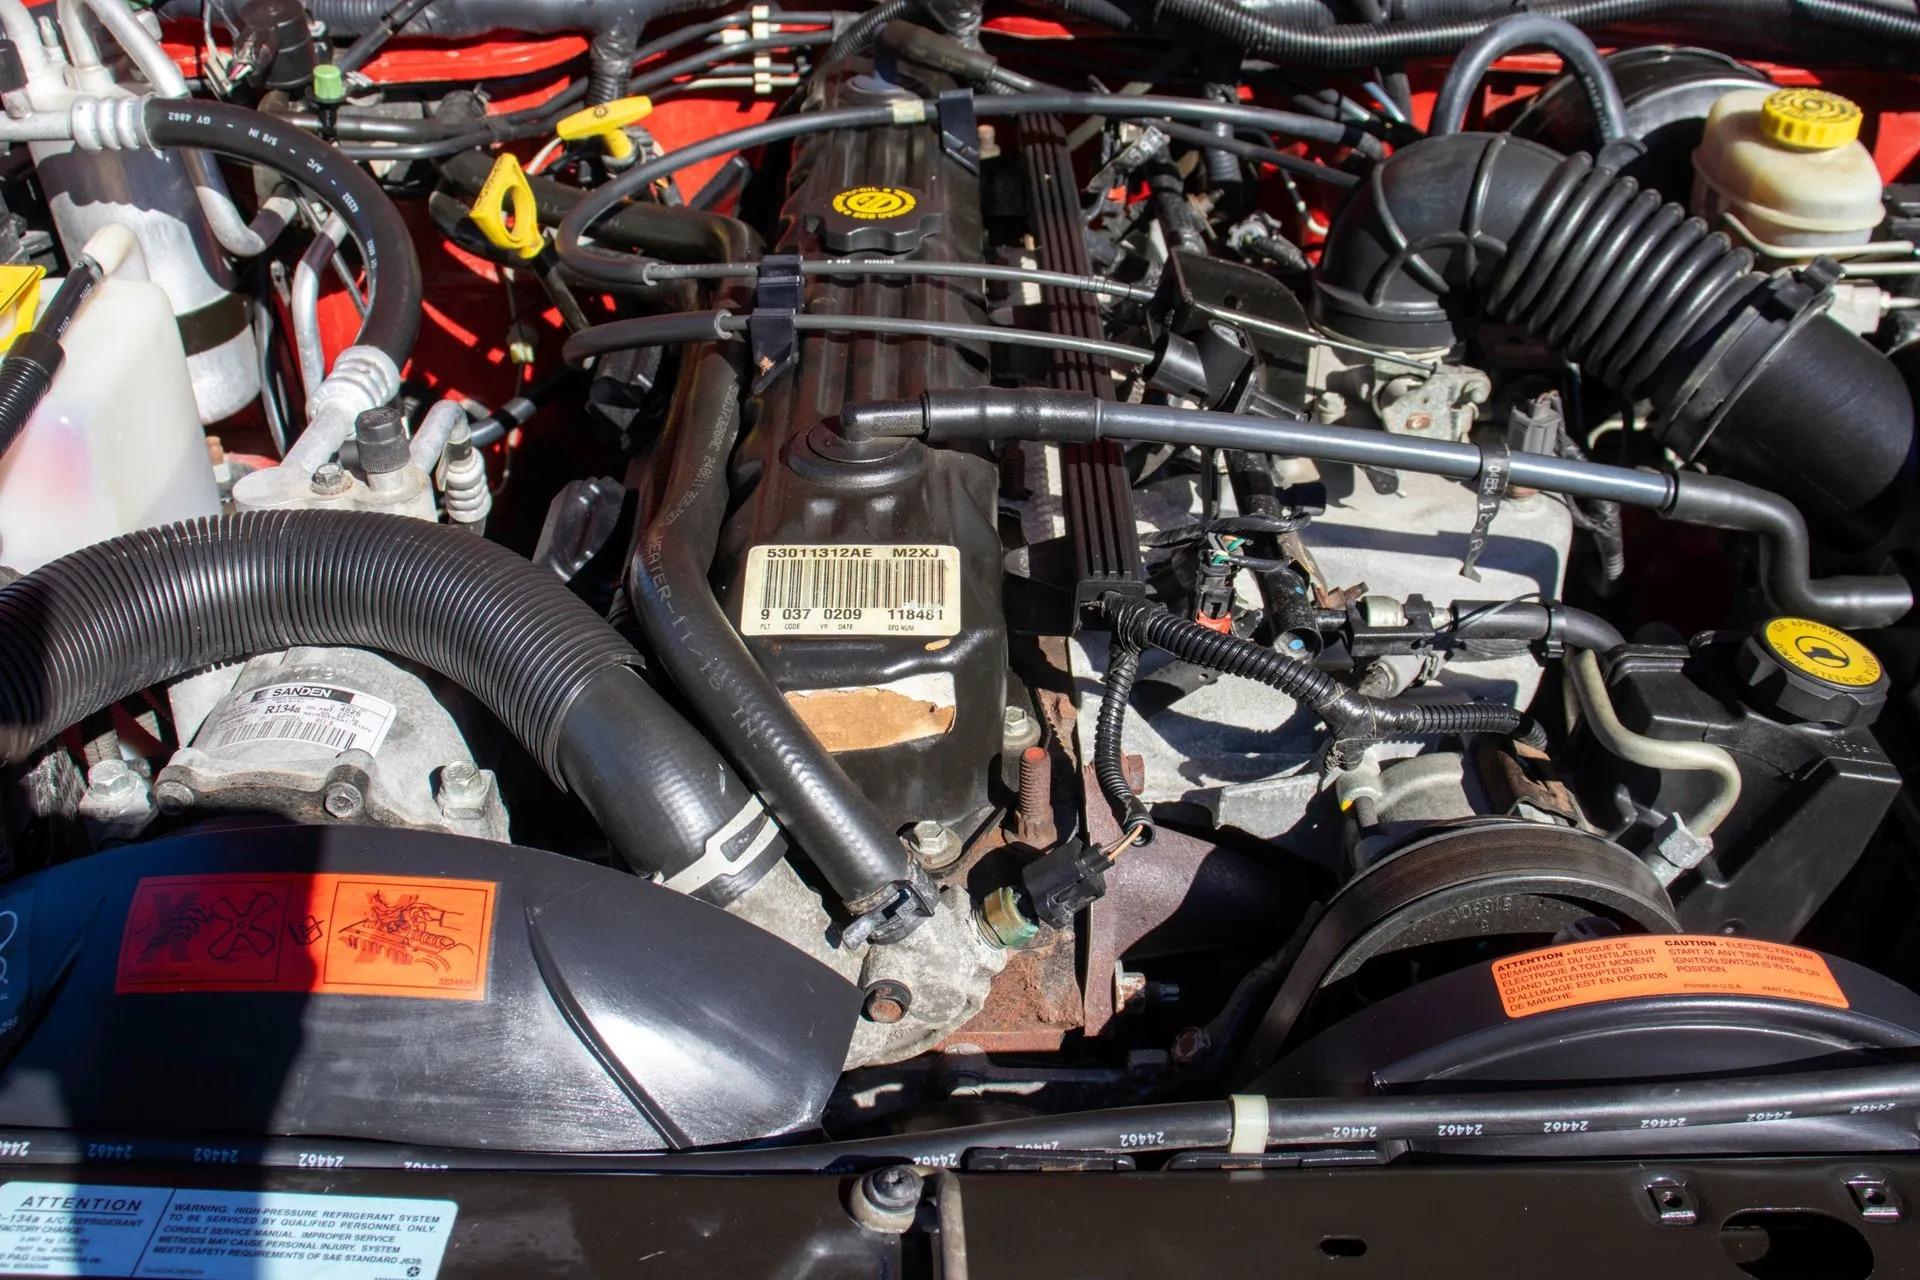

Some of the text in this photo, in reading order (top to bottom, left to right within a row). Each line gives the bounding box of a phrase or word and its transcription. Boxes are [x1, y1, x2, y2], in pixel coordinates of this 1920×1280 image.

[248, 128, 259, 138] IN
[306, 158, 324, 174] A/C
[767, 548, 940, 558] 53011312AE M2XJ
[760, 609, 770, 620] 9
[782, 609, 810, 620] 037
[824, 609, 862, 620] 0209
[1792, 620, 1848, 642] APPROVED
[272, 688, 332, 698] SANDEN
[264, 704, 301, 715] R134a
[1726, 942, 1775, 952] ELECTRIC
[1776, 948, 1794, 956] FAN
[1497, 952, 1563, 972] ATTENTION
[1573, 944, 1612, 956] RISQUE
[1615, 942, 1630, 950] DE
[1500, 948, 1656, 980] DEMARRAGE DU VENTILATEUR
[1578, 961, 1608, 970] TOUT
[1610, 956, 1656, 966] MOMENT
[1766, 954, 1794, 964] WHEN
[1720, 958, 1760, 968] SWITCH
[1784, 964, 1803, 974] THE
[1804, 968, 1820, 976] ON
[1504, 982, 1542, 996] QUAND
[1507, 972, 1668, 1004] D'ALLUMAGE EST EN POSITION
[1510, 1004, 1525, 1012] DE
[1850, 1102, 1896, 1114] 24462
[1640, 1117, 1686, 1129] 24462
[1747, 1110, 1792, 1122] 24462
[1332, 1126, 1377, 1138] 24462
[1438, 1124, 1482, 1136] 24462
[1544, 1120, 1588, 1133] 24462
[1120, 1131, 1164, 1147] 24462
[88, 1144, 132, 1160] 24462
[193, 1148, 238, 1164] 24462
[300, 1153, 344, 1168] 24462
[20, 1196, 142, 1211] ATTENTION
[46, 1216, 65, 1224] A/C
[70, 1217, 144, 1226] REFRIGERANT
[234, 1207, 318, 1217] HIGH-PRESSURE
[322, 1211, 394, 1221] REFRIGERANT
[398, 1214, 440, 1223] SYSTEM
[188, 1214, 200, 1222] BE
[206, 1216, 258, 1224] SERVICED
[281, 1219, 335, 1228] QUALIFIED
[340, 1222, 402, 1231] PERSONNEL
[408, 1225, 436, 1233] ONLY.
[164, 1226, 208, 1234] CONSULT
[210, 1228, 250, 1236] SERVICE
[302, 1232, 354, 1240] IMPROPER
[354, 1234, 396, 1242] SERVICE
[158, 1236, 206, 1244] METHODS
[230, 1239, 264, 1248] CAUSE
[266, 1240, 317, 1250] PERSONAL
[362, 1244, 400, 1254] SYSTEM
[8, 1253, 29, 1261] PAG
[153, 1246, 188, 1254] MEETS
[188, 1247, 226, 1256] SAFETY
[228, 1248, 304, 1260] REQUIREMENTS
[344, 1254, 398, 1264] STANDARD
